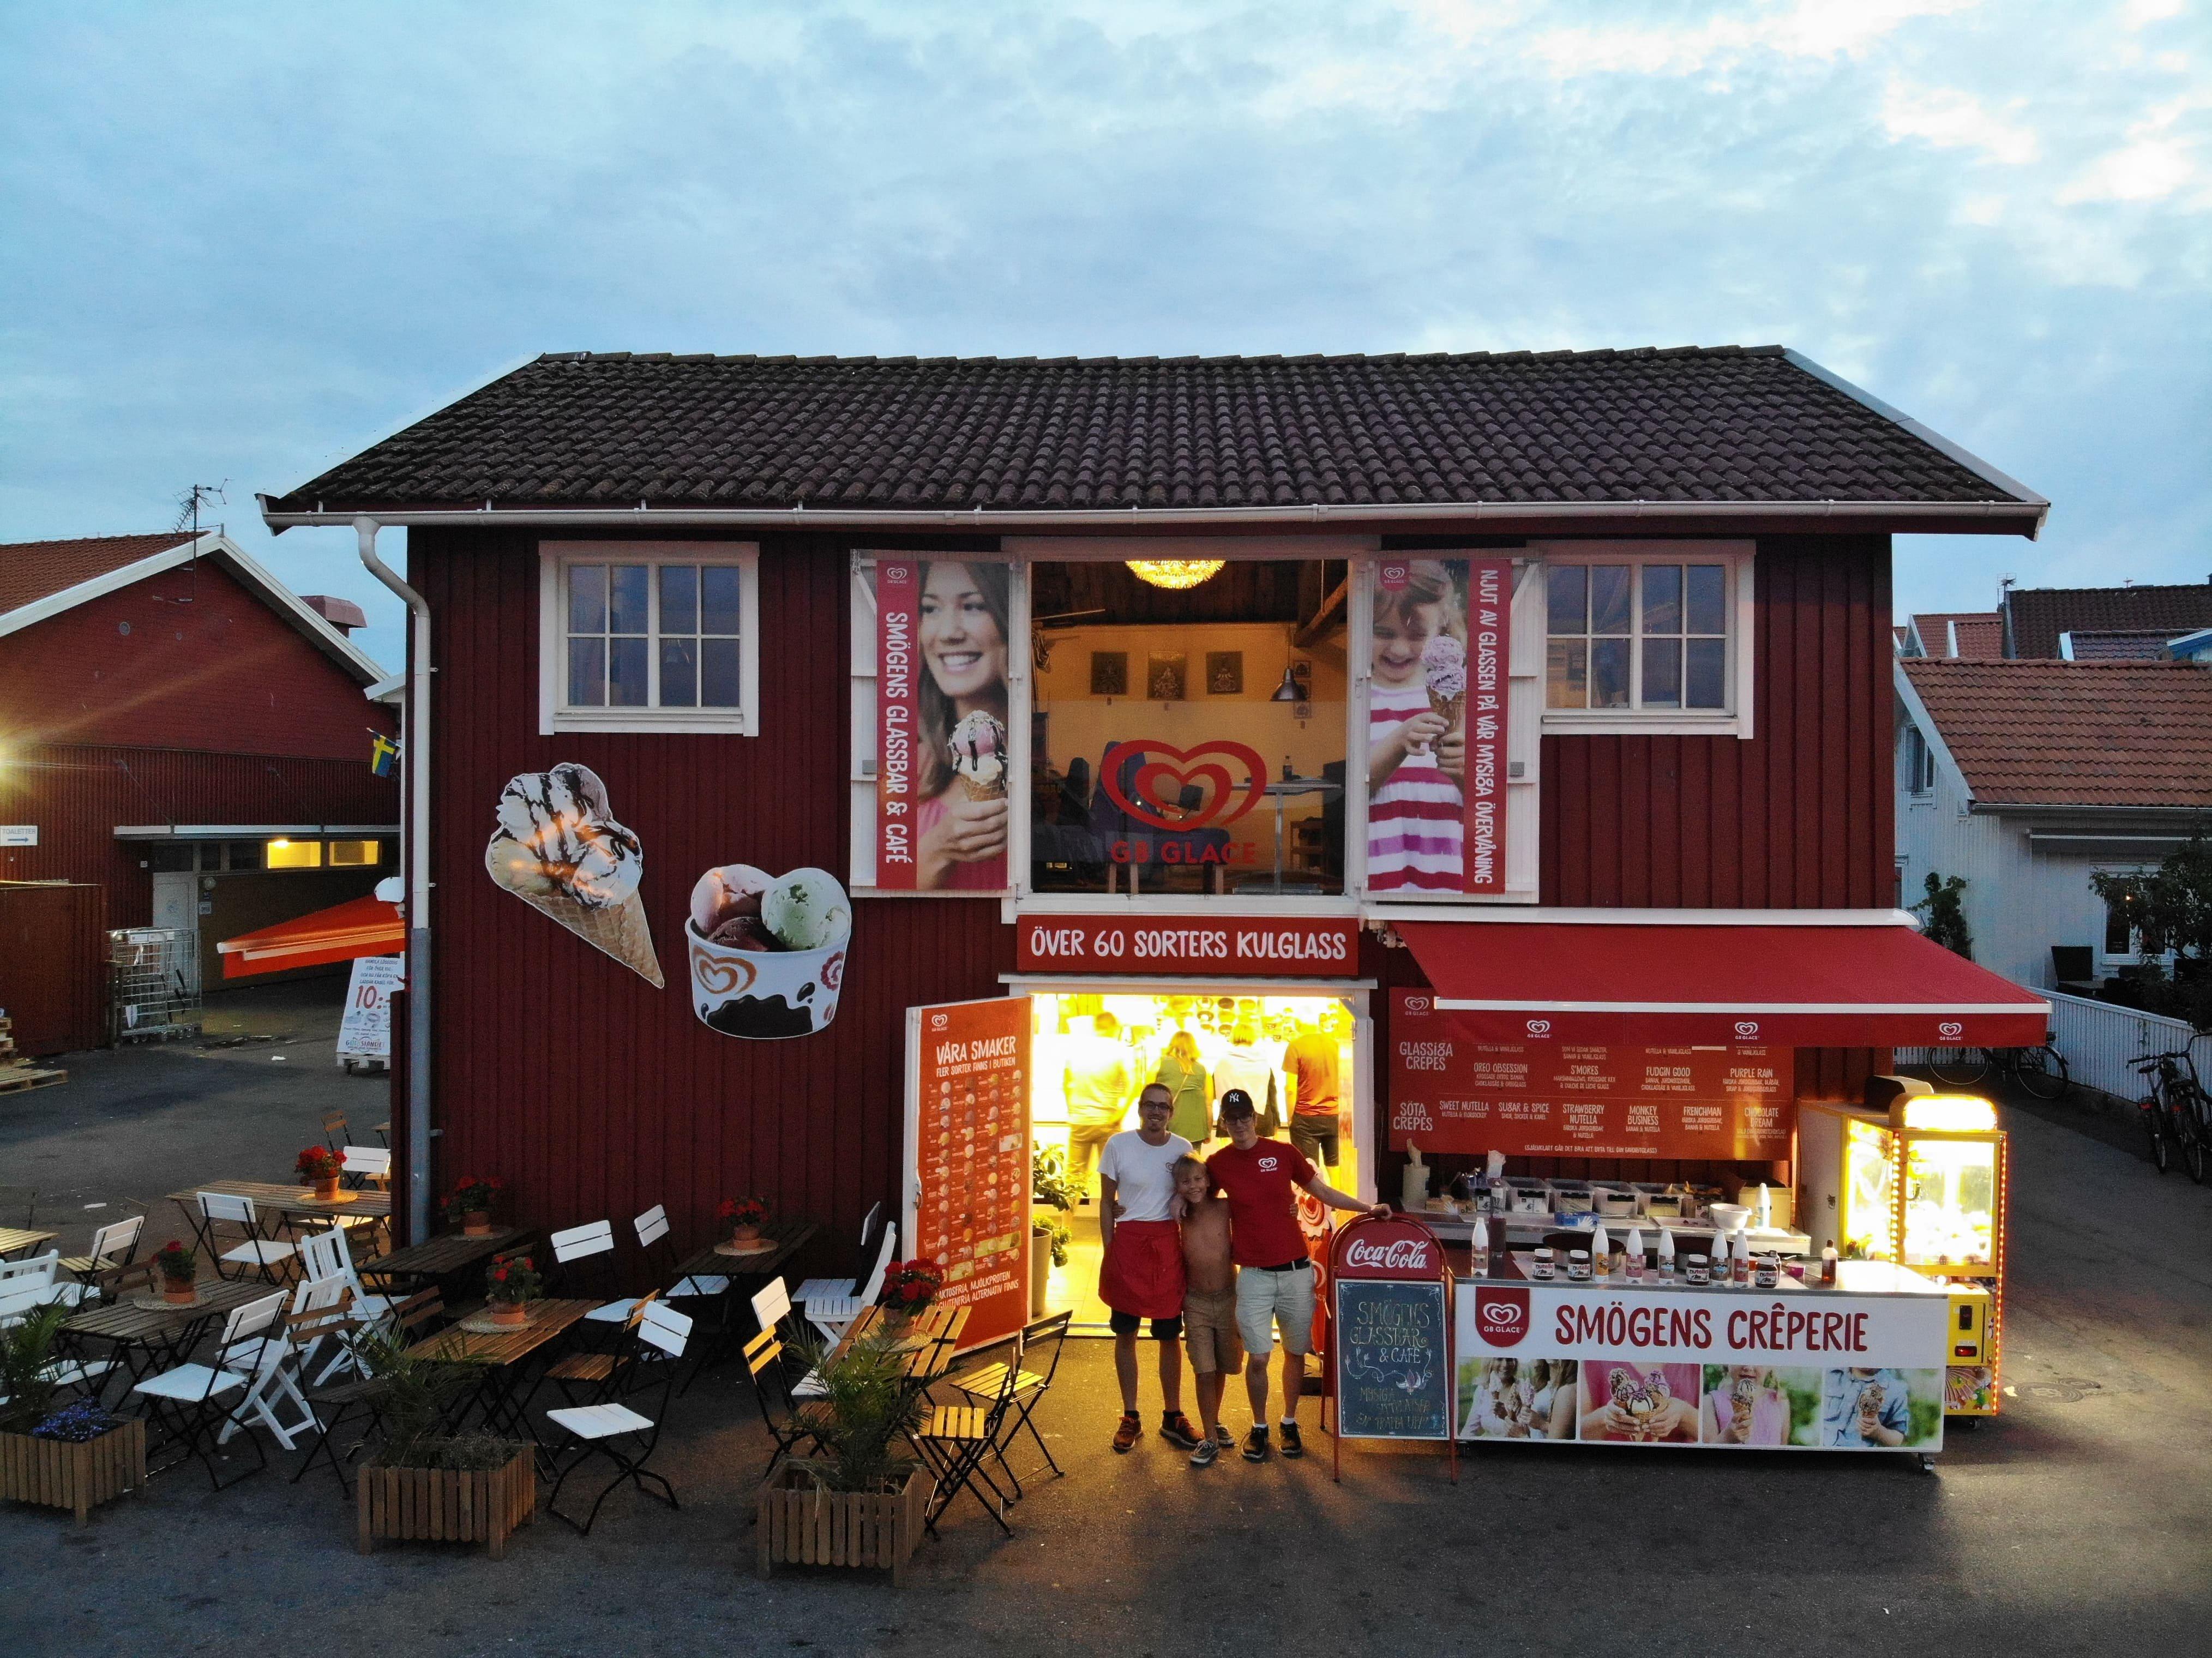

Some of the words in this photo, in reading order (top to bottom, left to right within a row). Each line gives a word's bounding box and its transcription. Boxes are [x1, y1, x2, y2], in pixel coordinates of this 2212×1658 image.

[1479, 569, 1499, 604] NJUT
[1478, 609, 1498, 627] AV
[886, 612, 911, 698] SMÖGENS
[1477, 632, 1497, 690] GLASSEN
[1476, 695, 1499, 711] PÅ
[1476, 715, 1499, 740] VÅR
[886, 705, 909, 794] GLASSBAR
[886, 801, 909, 816] &
[886, 824, 913, 863] CAFÉ
[1110, 840, 1150, 864] GB
[1161, 841, 1255, 865] GLACE
[1031, 926, 1085, 956] ÖVER
[1094, 930, 1124, 957] 60
[1134, 930, 1228, 959] SORTERS
[1237, 931, 1346, 960] KULGLASS
[936, 1041, 967, 1066] VÅRA
[971, 1035, 1016, 1060] SMAKER
[936, 1067, 949, 1078] FLER
[951, 1064, 971, 1076] SORTER
[973, 1060, 988, 1072] FINNS
[993, 1056, 1016, 1069] BUTIKEN
[1405, 1056, 1446, 1071] CREPES
[1474, 1062, 1490, 1073] OREO
[1493, 1063, 1528, 1073] OBSESSION
[1571, 1065, 1599, 1075] S'MORES
[1673, 1067, 1691, 1077] GOOD
[1730, 1067, 1755, 1078] PURPLE
[1400, 1101, 1427, 1117] SÖTA
[1439, 1100, 1459, 1110] SWEET
[1461, 1101, 1489, 1112] NUTELLA
[1498, 1102, 1521, 1112] SUGAR
[1523, 1103, 1529, 1113] &
[1531, 1102, 1549, 1113] SPICE
[1562, 1103, 1605, 1115] STRAWBERRY
[1629, 1105, 1657, 1115] MONKEY
[1684, 1106, 1722, 1116] FRENCHMAN
[1744, 1107, 1779, 1118] CHOCOLATE
[1392, 1116, 1433, 1131] CREPES
[1570, 1114, 1597, 1124] NUTELLA
[1627, 1115, 1659, 1125] BUSINESS
[1750, 1117, 1773, 1127] DREAM
[1346, 1238, 1429, 1269] Coca-Cola
[972, 1284, 1003, 1302] ALTERNATIV
[1004, 1279, 1019, 1292] FINNS
[1356, 1299, 1430, 1328] SMÖGENS
[1555, 1301, 1712, 1349] SMÖGENS
[1727, 1302, 1868, 1352] CRÊPERIE
[1350, 1326, 1428, 1348] GLASSBAR
[1379, 1348, 1388, 1362] &
